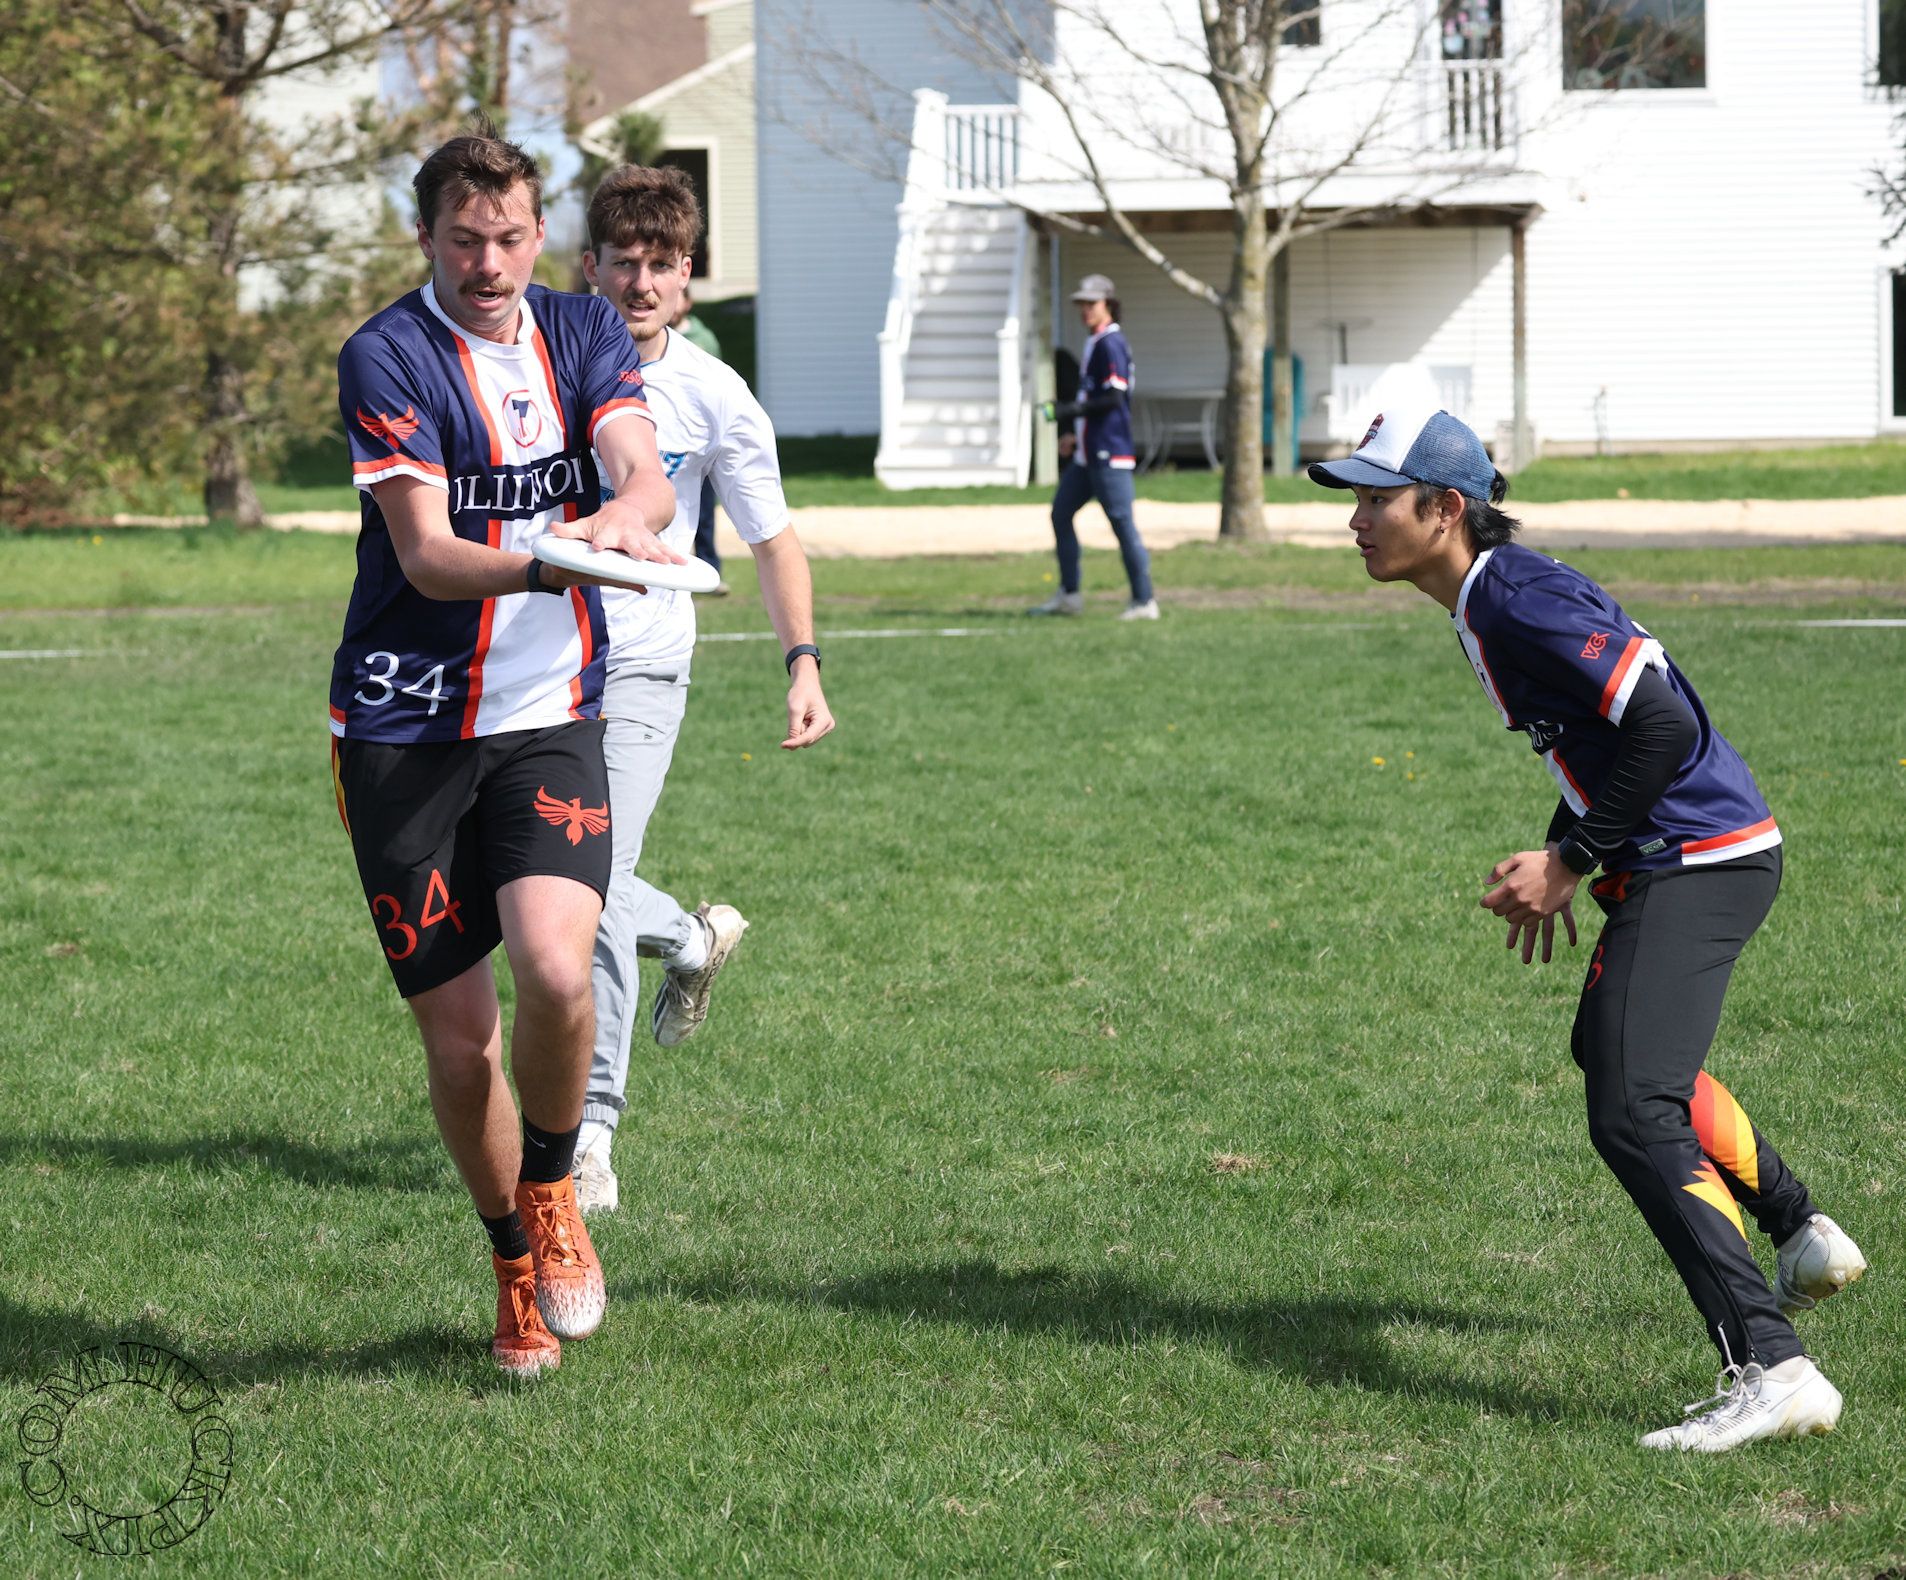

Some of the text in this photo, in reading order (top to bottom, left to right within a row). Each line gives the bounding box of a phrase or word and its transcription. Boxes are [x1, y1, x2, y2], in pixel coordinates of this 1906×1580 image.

[453, 457, 584, 514] ILLINOI
[354, 651, 449, 716] 34
[372, 869, 465, 960] 34
